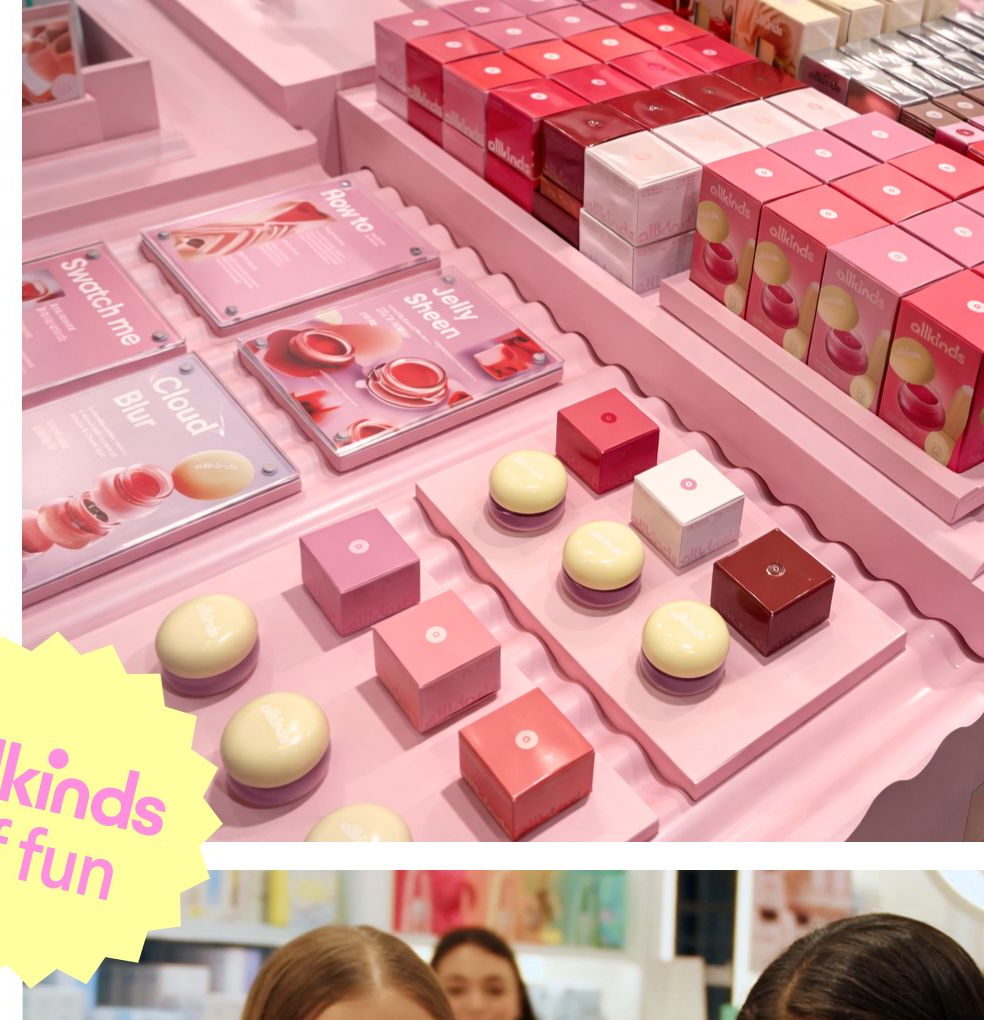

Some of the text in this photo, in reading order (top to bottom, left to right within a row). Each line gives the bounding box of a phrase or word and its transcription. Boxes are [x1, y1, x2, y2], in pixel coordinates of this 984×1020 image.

[487, 137, 534, 174] allkinds
[710, 183, 752, 219] allkinds
[349, 216, 374, 233] to
[769, 224, 815, 263] allkinds
[60, 257, 141, 346] Swatch me
[431, 286, 479, 322] Jelly
[836, 268, 885, 311] allkinds
[403, 292, 461, 341] Sheen
[910, 321, 966, 365] allkinds
[112, 389, 157, 428] Blur
[153, 376, 216, 436] Cloud
